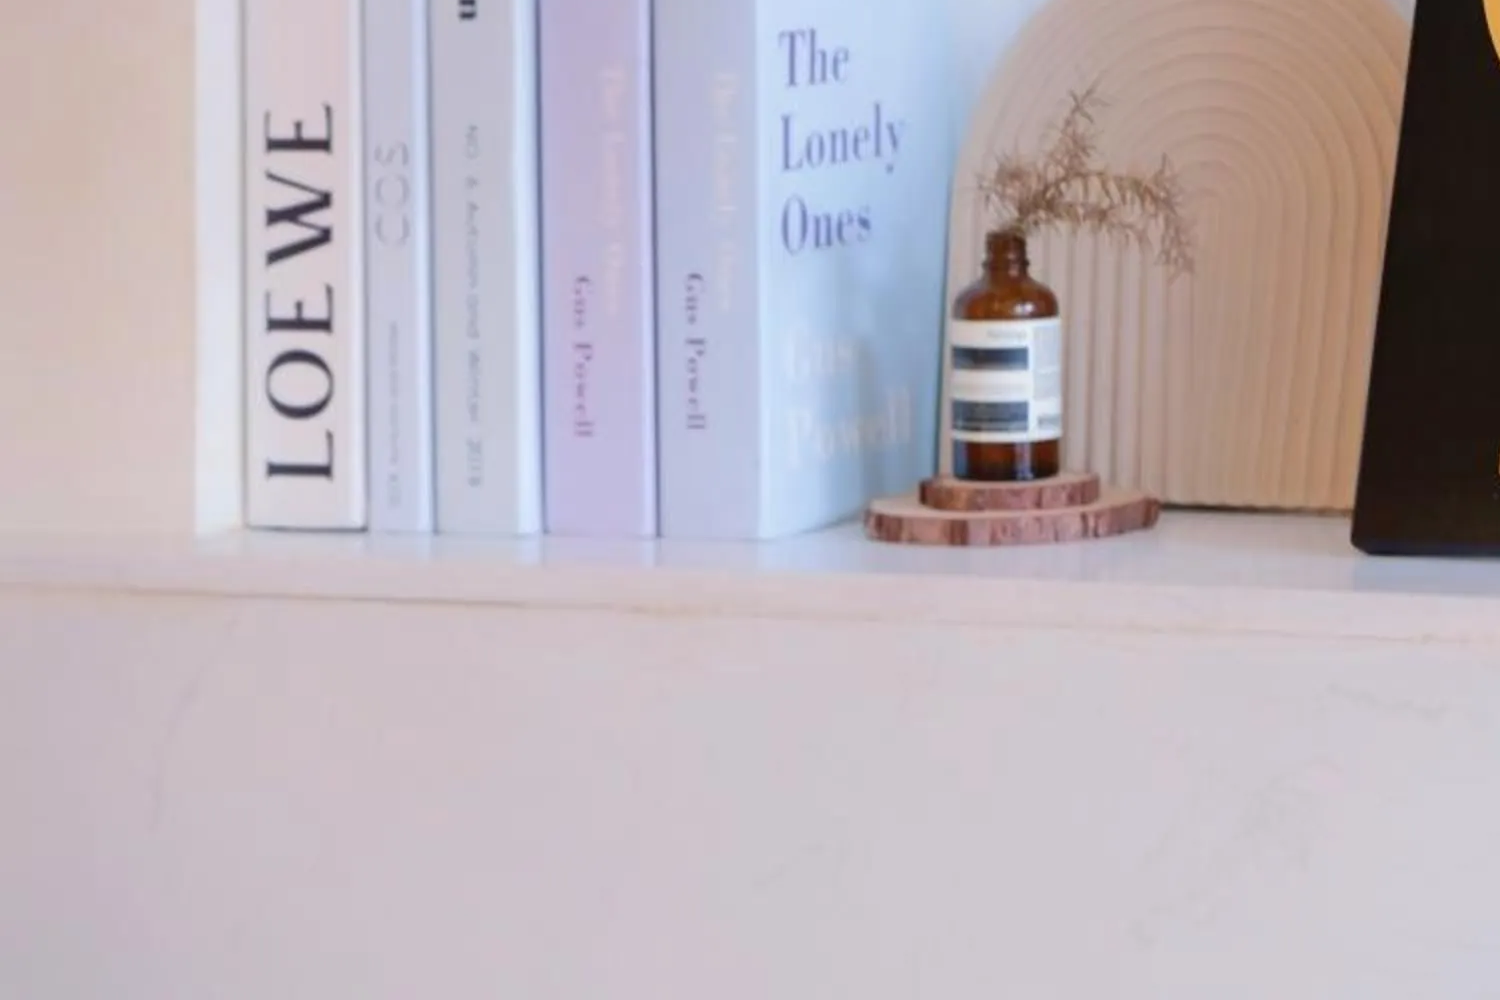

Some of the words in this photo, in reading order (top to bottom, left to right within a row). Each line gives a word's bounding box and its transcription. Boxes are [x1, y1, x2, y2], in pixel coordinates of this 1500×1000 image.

[778, 27, 850, 88] The
[780, 101, 904, 174] Lonely
[780, 195, 872, 255] Ones
[265, 100, 334, 482] LOEWE
